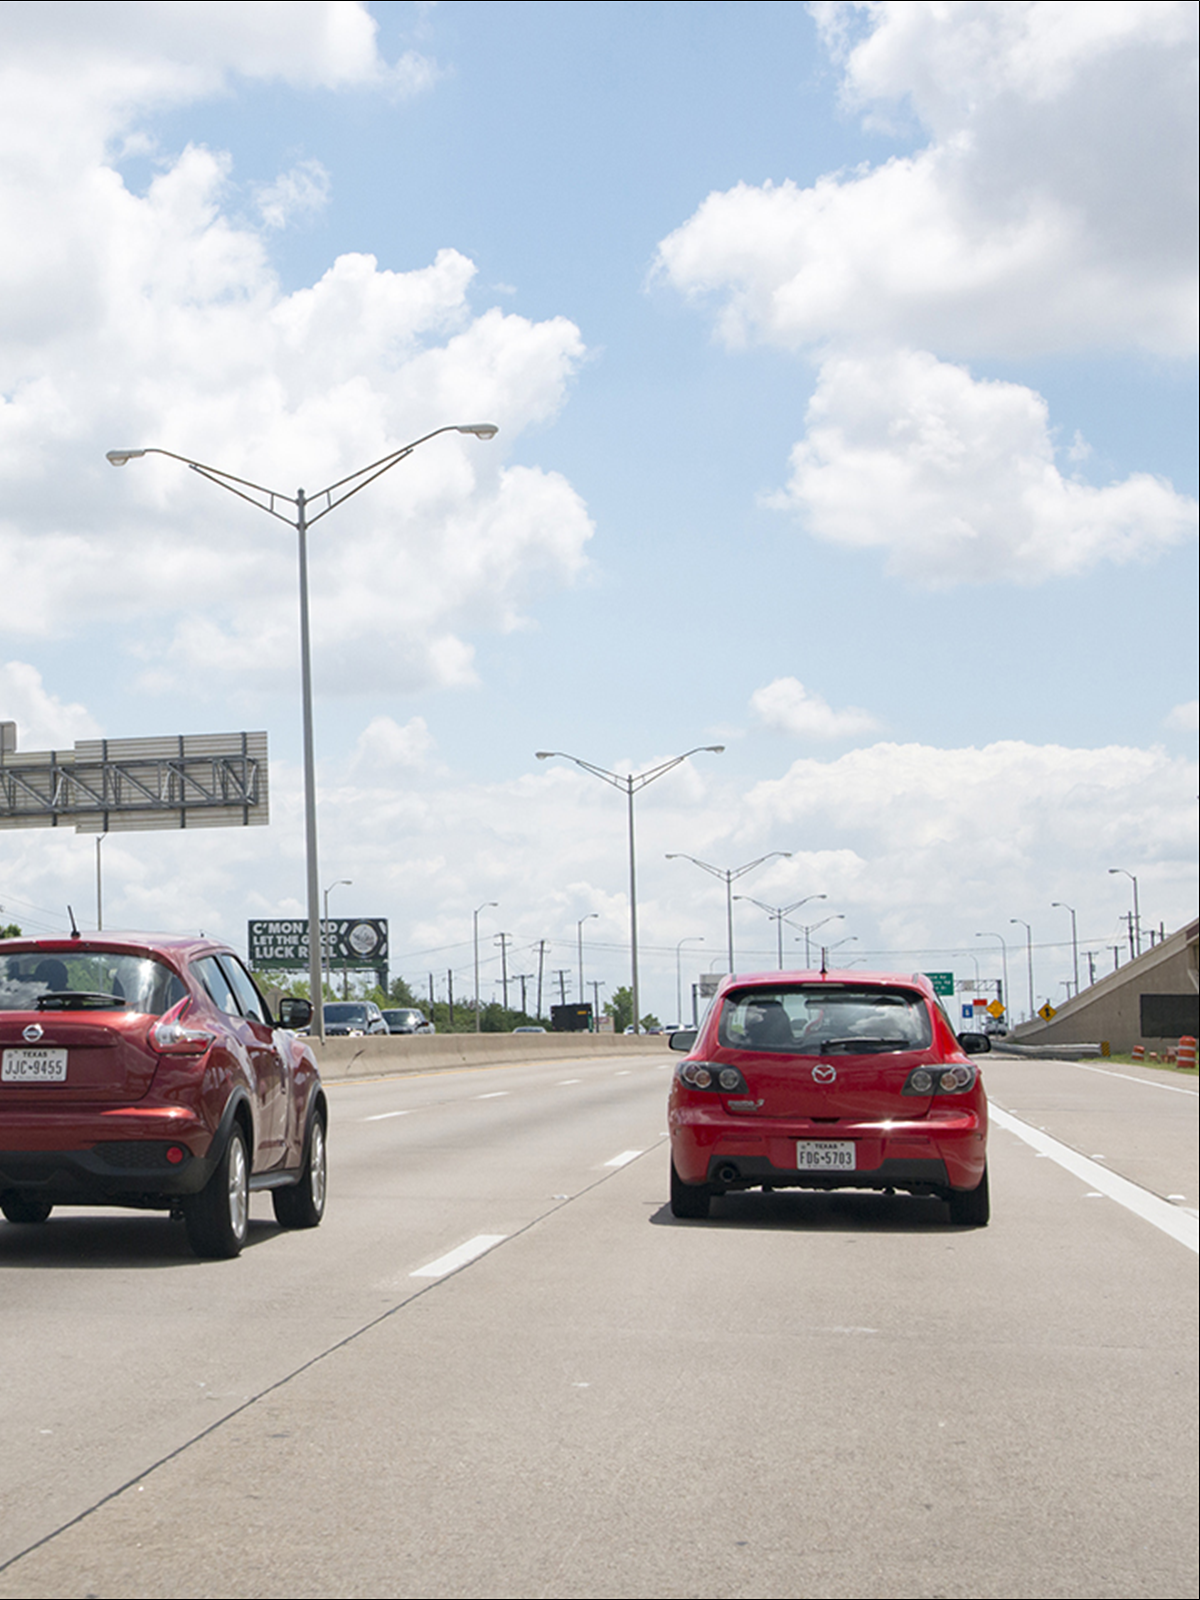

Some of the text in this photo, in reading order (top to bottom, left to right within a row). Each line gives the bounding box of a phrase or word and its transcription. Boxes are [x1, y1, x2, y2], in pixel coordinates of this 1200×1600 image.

[253, 922, 338, 934] C'MON ND
[253, 935, 338, 945] LET THE GOD
[255, 946, 337, 958] LUCK RLL
